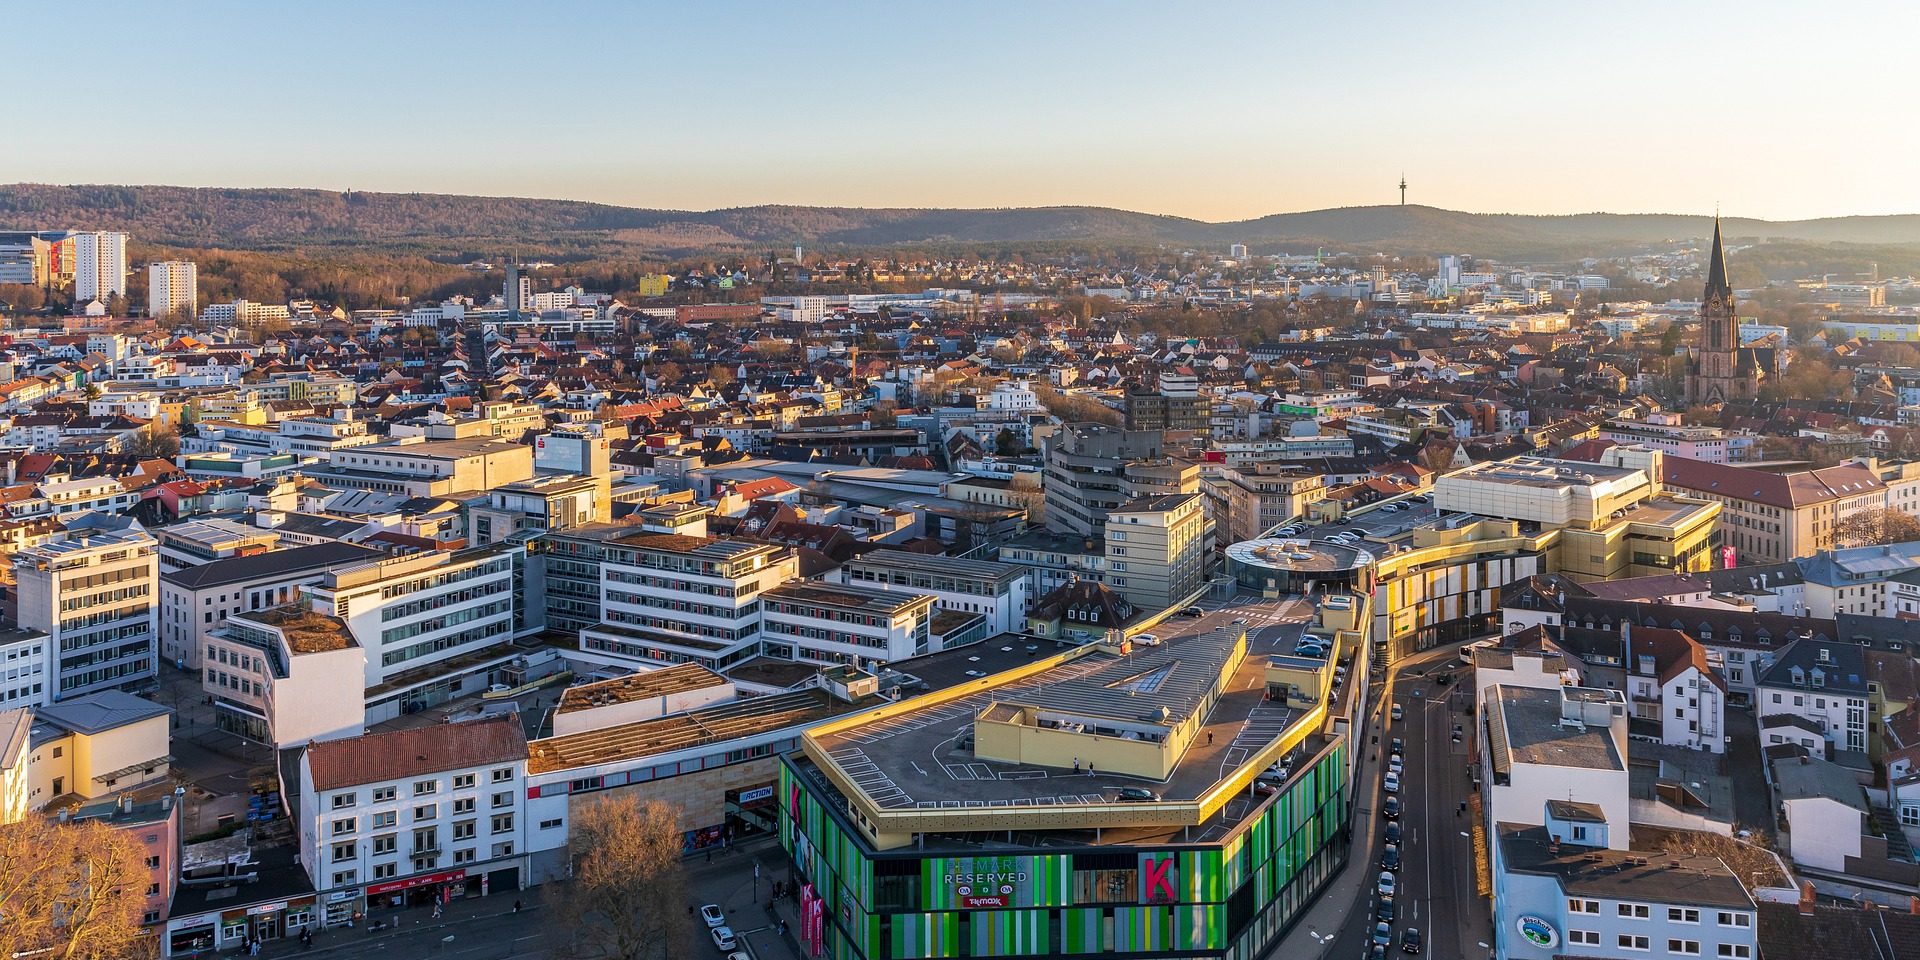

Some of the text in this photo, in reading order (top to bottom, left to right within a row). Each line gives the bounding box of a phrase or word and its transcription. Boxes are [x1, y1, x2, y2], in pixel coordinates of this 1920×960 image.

[745, 788, 772, 800] ACTION
[944, 873, 1026, 884] RESERVED
[1145, 858, 1175, 899] K
[803, 884, 812, 900] K
[813, 899, 822, 916] K
